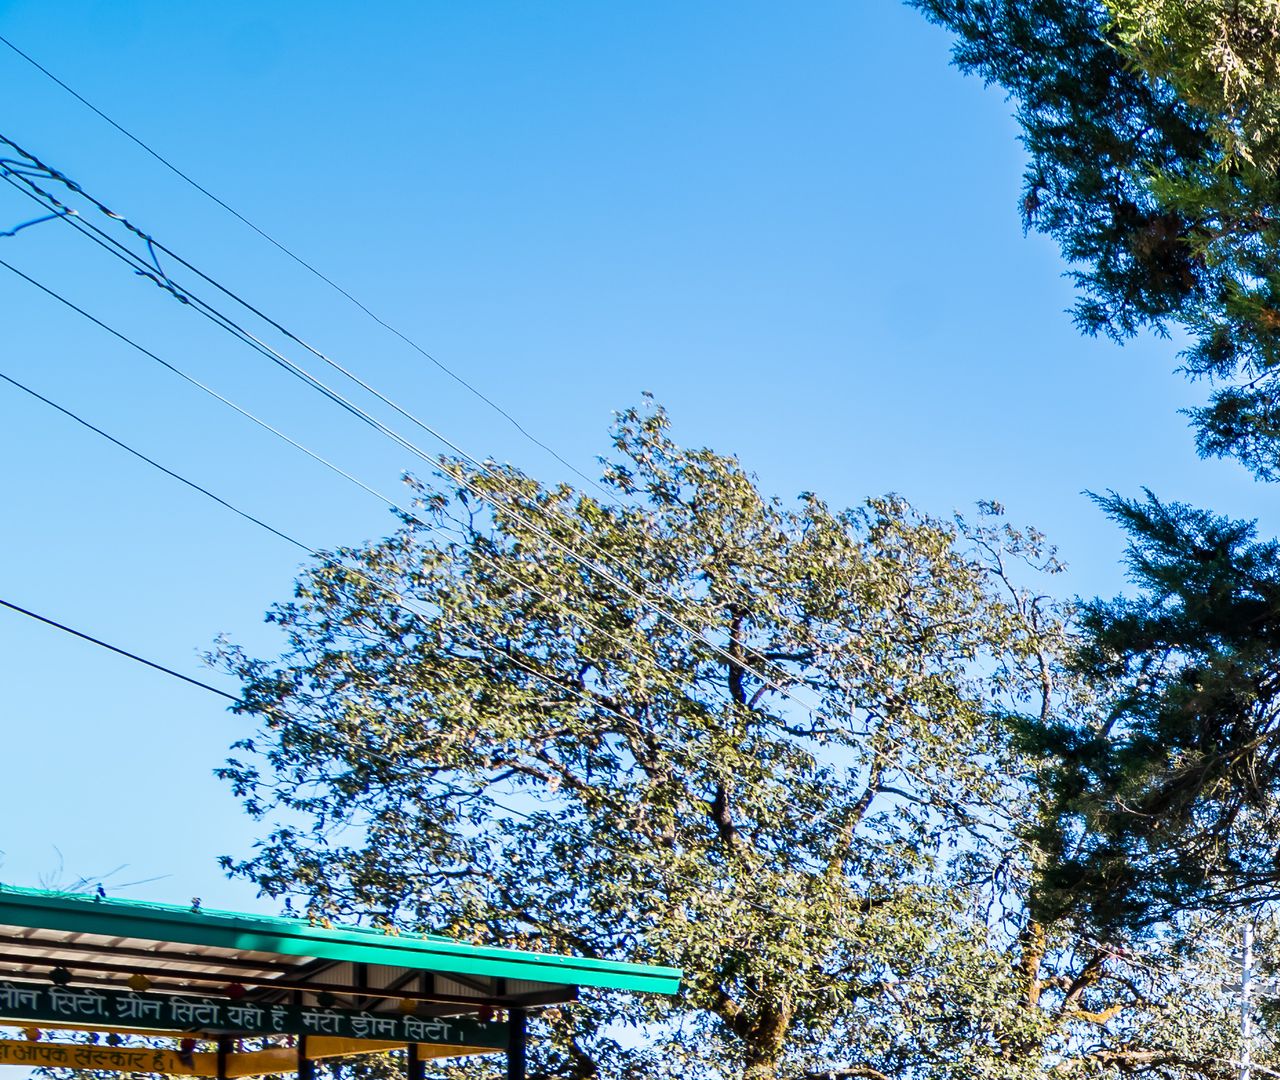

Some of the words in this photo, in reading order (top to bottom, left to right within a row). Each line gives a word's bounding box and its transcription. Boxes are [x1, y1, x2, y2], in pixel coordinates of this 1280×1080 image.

[116, 992, 164, 1019] ग्रीन
[227, 1002, 265, 1029] यही
[270, 1005, 288, 1031] है
[350, 1011, 397, 1038] ड्रीम
[13, 1044, 69, 1063] आपके
[75, 1046, 148, 1068] संस्कार
